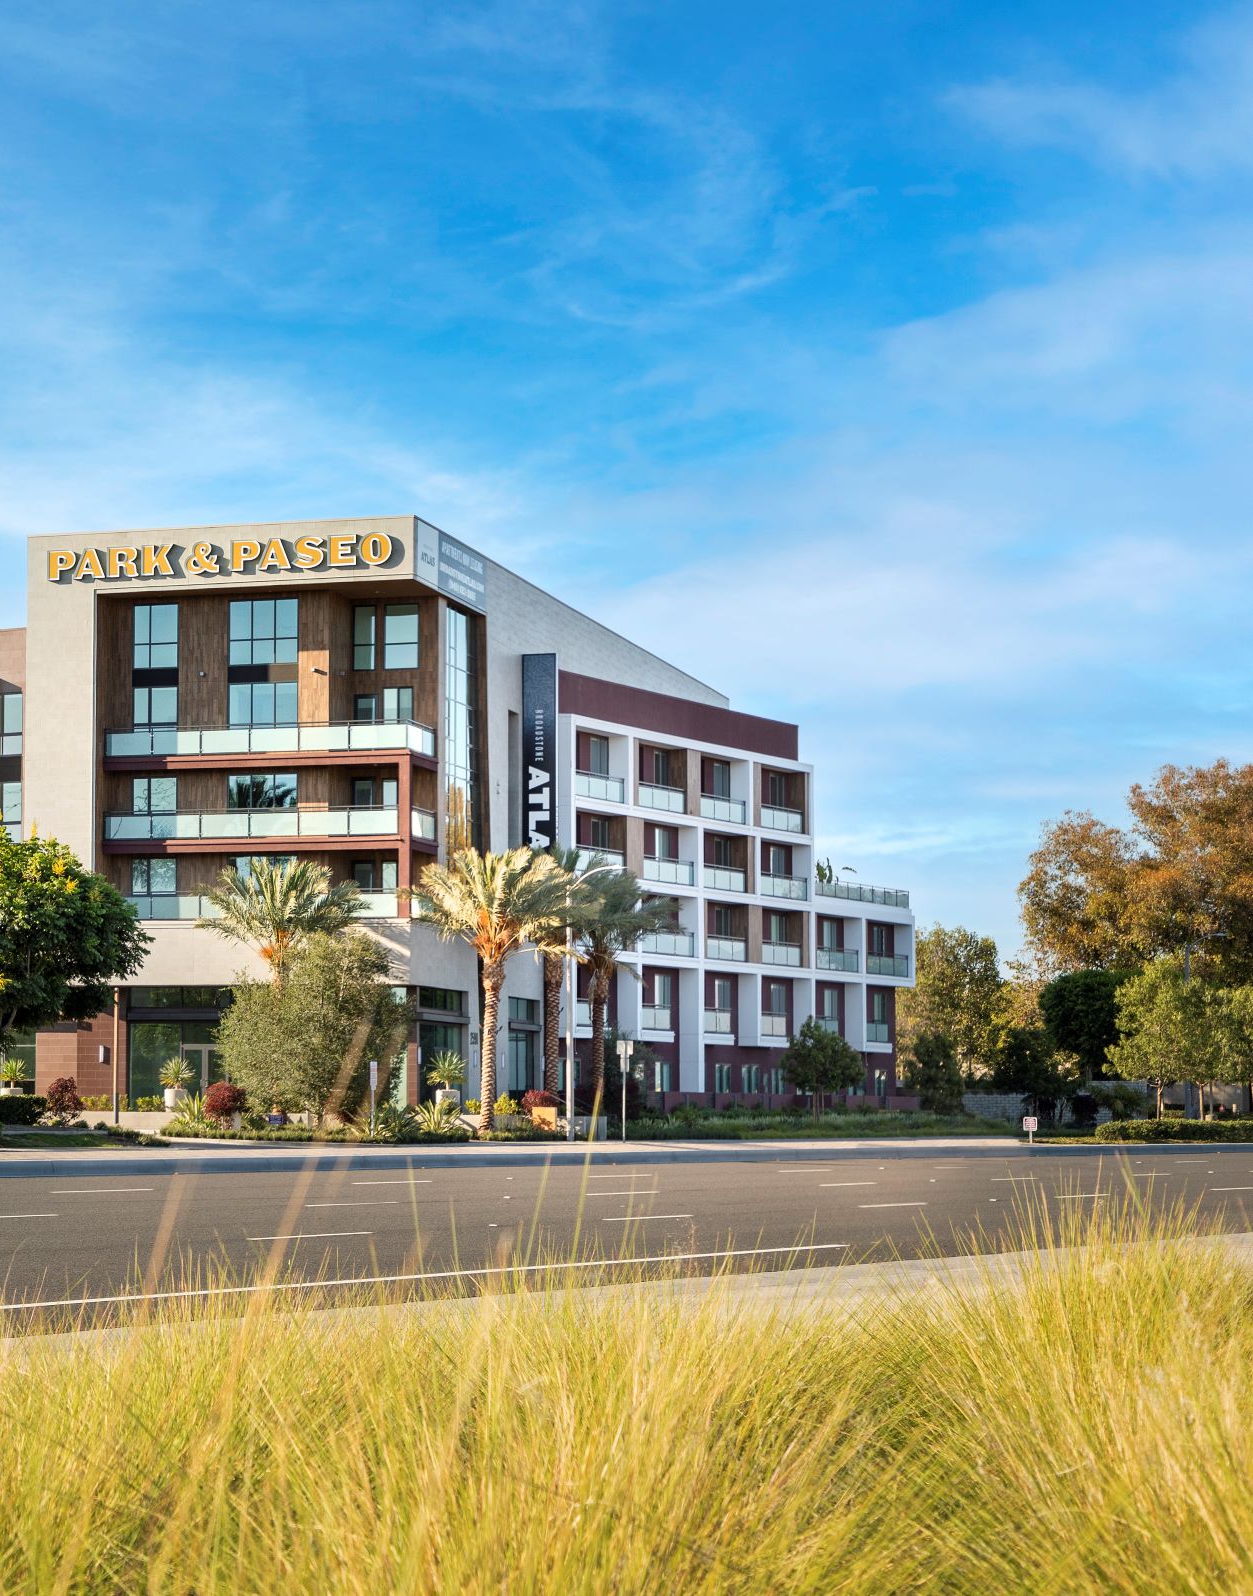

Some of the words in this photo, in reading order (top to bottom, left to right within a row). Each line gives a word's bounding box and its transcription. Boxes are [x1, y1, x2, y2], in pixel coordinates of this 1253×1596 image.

[47, 544, 175, 581] PARK
[186, 541, 220, 575] &
[230, 532, 393, 572] PASEO
[421, 551, 436, 567] ATLAS
[534, 709, 544, 762] BROADSTONE
[528, 765, 550, 850] ATLA
